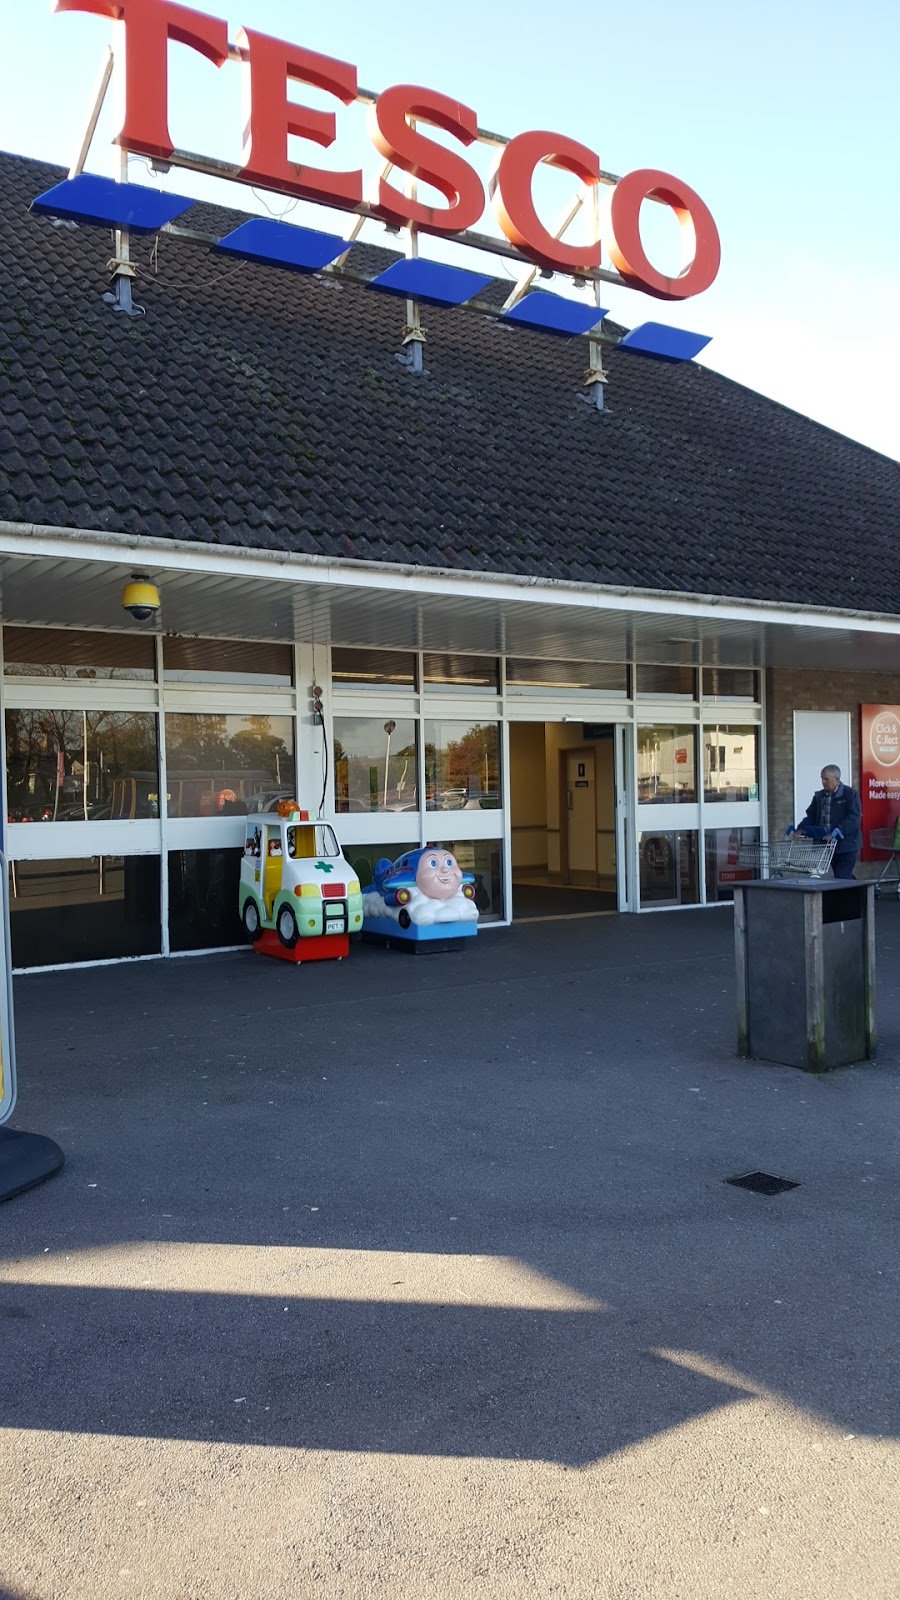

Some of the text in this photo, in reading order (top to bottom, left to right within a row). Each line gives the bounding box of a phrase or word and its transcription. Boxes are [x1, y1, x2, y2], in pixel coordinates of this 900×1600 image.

[54, 0, 721, 300] TESCO
[869, 778, 884, 788] More
[869, 790, 886, 800] Made
